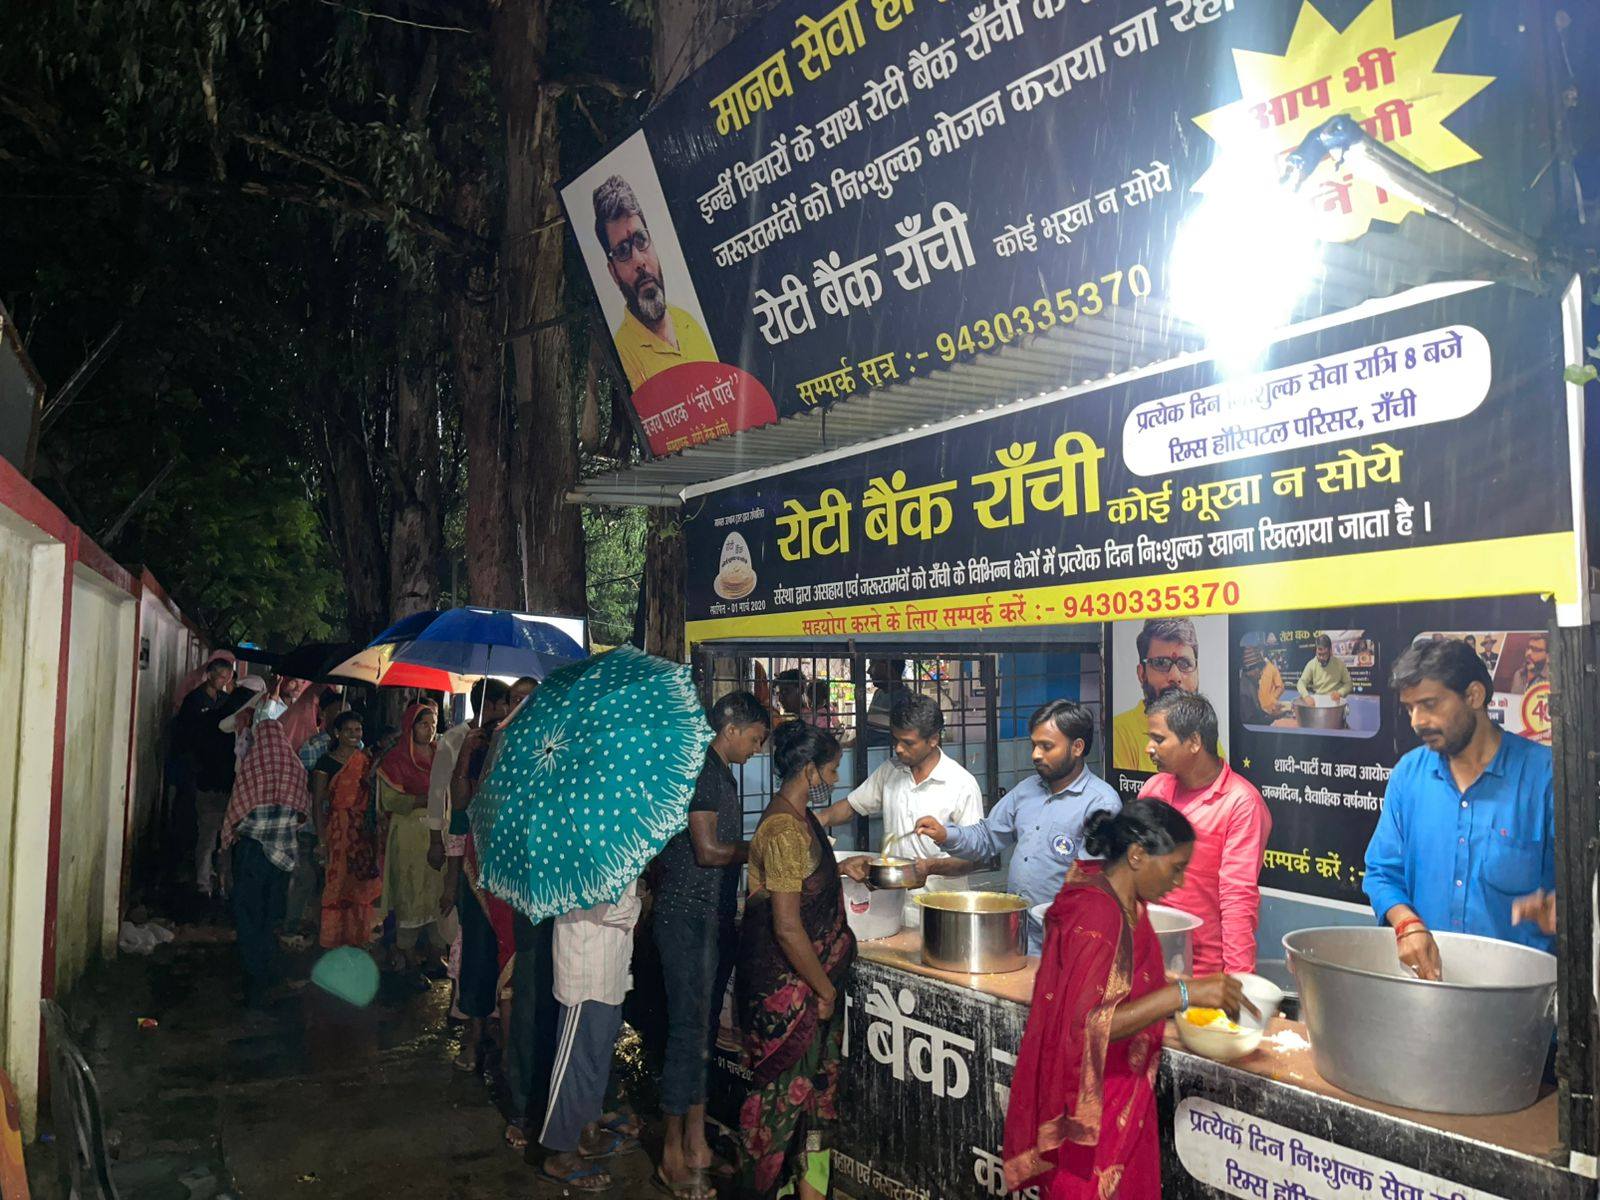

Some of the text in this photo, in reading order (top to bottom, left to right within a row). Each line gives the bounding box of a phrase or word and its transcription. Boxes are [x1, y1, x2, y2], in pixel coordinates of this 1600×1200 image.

[709, 48, 794, 136] मानव
[791, 0, 867, 81] सेवा
[1248, 75, 1333, 129] आप
[1343, 47, 1397, 93] भी
[697, 167, 737, 225] इन्हीं
[732, 131, 793, 199] विचारों
[791, 124, 816, 162] के
[816, 100, 863, 149] साथ
[862, 65, 909, 123] रोटी
[908, 41, 958, 90] बैंक
[960, 0, 1024, 61] राँची
[713, 192, 801, 269] जरूरतमंदों
[800, 183, 833, 223] को
[926, 90, 1006, 157] भोजन
[1006, 35, 1107, 112] कराया
[1109, 6, 1160, 57] जा
[752, 161, 1173, 346] रोटी बैंक राँची कोई भूखा न सोये
[796, 357, 856, 406] सम्पर्क
[936, 264, 1152, 363] 9430335370
[1136, 402, 1186, 434] प्रत्येक
[1190, 392, 1221, 419] दिन
[1308, 363, 1348, 391] सेवा
[1354, 346, 1397, 381] रात्रि
[1405, 348, 1417, 370] 8
[1423, 330, 1463, 364] बजे
[1168, 437, 1208, 464] रिम्स
[1293, 400, 1365, 439] परिसर,
[1371, 387, 1418, 424] राँची
[775, 431, 1105, 562] रोटी बैंक राँची
[1107, 441, 1404, 526] कोई भूखा न सोये
[773, 582, 794, 605] संस्था
[795, 585, 812, 604] द्वारा
[812, 581, 844, 601] असहाय
[845, 573, 860, 599] एवं
[859, 566, 910, 595] जरूरतमंदों
[911, 566, 927, 590] को
[929, 562, 951, 589] राँची
[953, 560, 966, 586] के
[968, 556, 1011, 585] विभिन्न
[1014, 548, 1041, 578] क्षेत्रों
[1042, 545, 1056, 575] में
[1057, 544, 1101, 577] प्रत्येक
[1104, 538, 1133, 568] दिन
[1208, 527, 1254, 554] खाना
[1259, 511, 1333, 551] खिलाया
[1338, 508, 1390, 540] जाता
[1394, 497, 1415, 537] है
[751, 599, 766, 611] 2020
[802, 611, 847, 635] सहयोग
[851, 608, 881, 632] करने
[886, 606, 901, 630] के
[905, 604, 938, 630] लिए
[943, 596, 994, 627] सम्पर्क
[999, 594, 1026, 622] करें
[1063, 580, 1240, 618] 9430335370
[1262, 783, 1302, 804] जन्मदिन,
[1304, 785, 1341, 806] वैवाहिक
[1274, 756, 1320, 776] शादी-पार्टी
[1321, 762, 1332, 777] या
[1334, 764, 1357, 779] अन्य
[1263, 848, 1311, 874] सम्पर्क
[1315, 852, 1342, 880] करें
[865, 981, 976, 1099] बैंक
[1189, 1109, 1243, 1144] प्रत्येक
[1248, 1124, 1285, 1161] दिन
[1225, 1158, 1268, 1199] रिम्स
